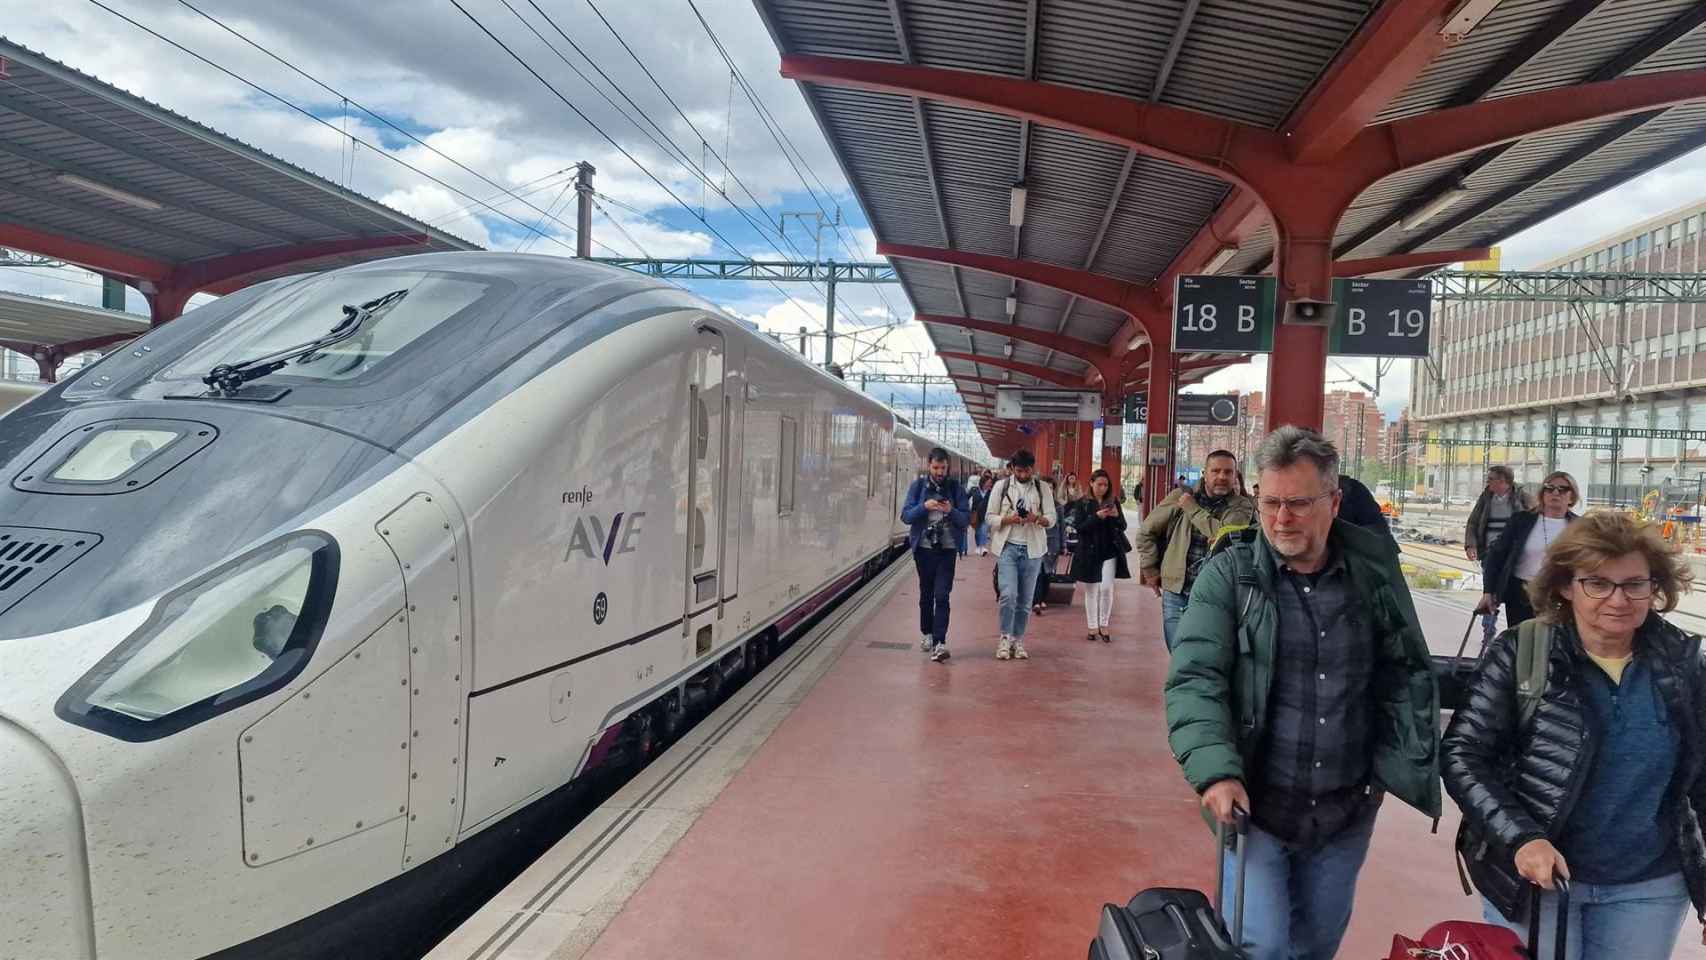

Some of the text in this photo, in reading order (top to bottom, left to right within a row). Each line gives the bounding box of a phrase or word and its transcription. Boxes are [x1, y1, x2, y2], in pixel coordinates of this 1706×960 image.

[1182, 304, 1255, 332] 18 B
[1348, 308, 1424, 337] B 19
[562, 484, 593, 509] renfe
[563, 511, 646, 567] AVE
